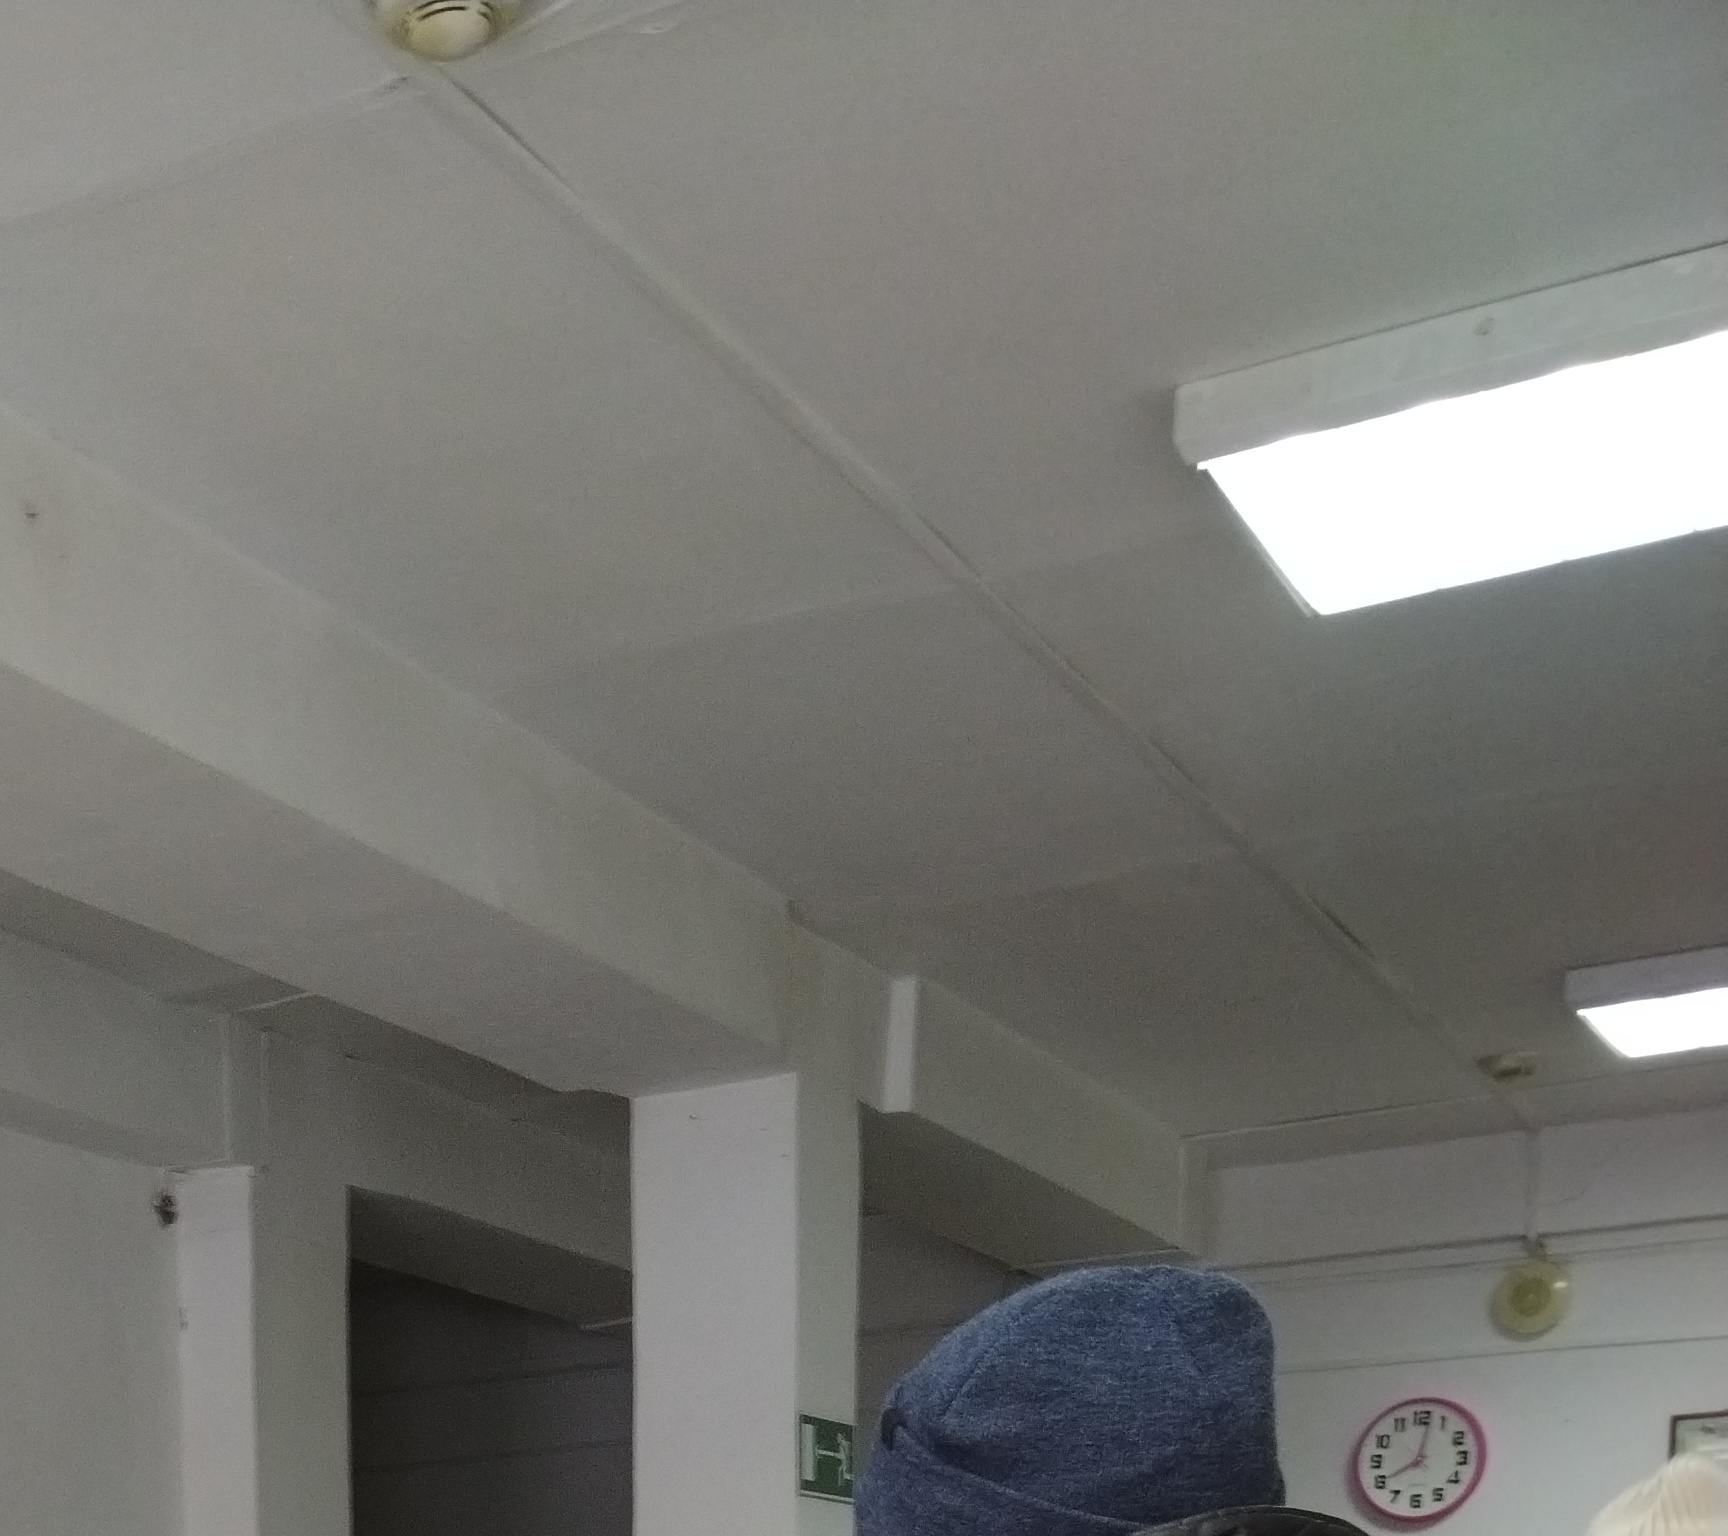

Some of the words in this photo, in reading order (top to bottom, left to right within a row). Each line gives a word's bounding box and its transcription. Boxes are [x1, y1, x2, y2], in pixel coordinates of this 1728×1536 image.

[1394, 1417, 1406, 1432] 11
[1413, 1410, 1431, 1426] 12
[1376, 1434, 1390, 1449] 10
[1452, 1431, 1464, 1446] 2
[1370, 1454, 1382, 1469] 9
[1456, 1450, 1468, 1465] 3
[1374, 1475, 1386, 1489] 8
[1446, 1470, 1460, 1484] 4
[1390, 1490, 1401, 1503] 7
[1410, 1494, 1422, 1508] 6
[1432, 1488, 1444, 1501] 5
